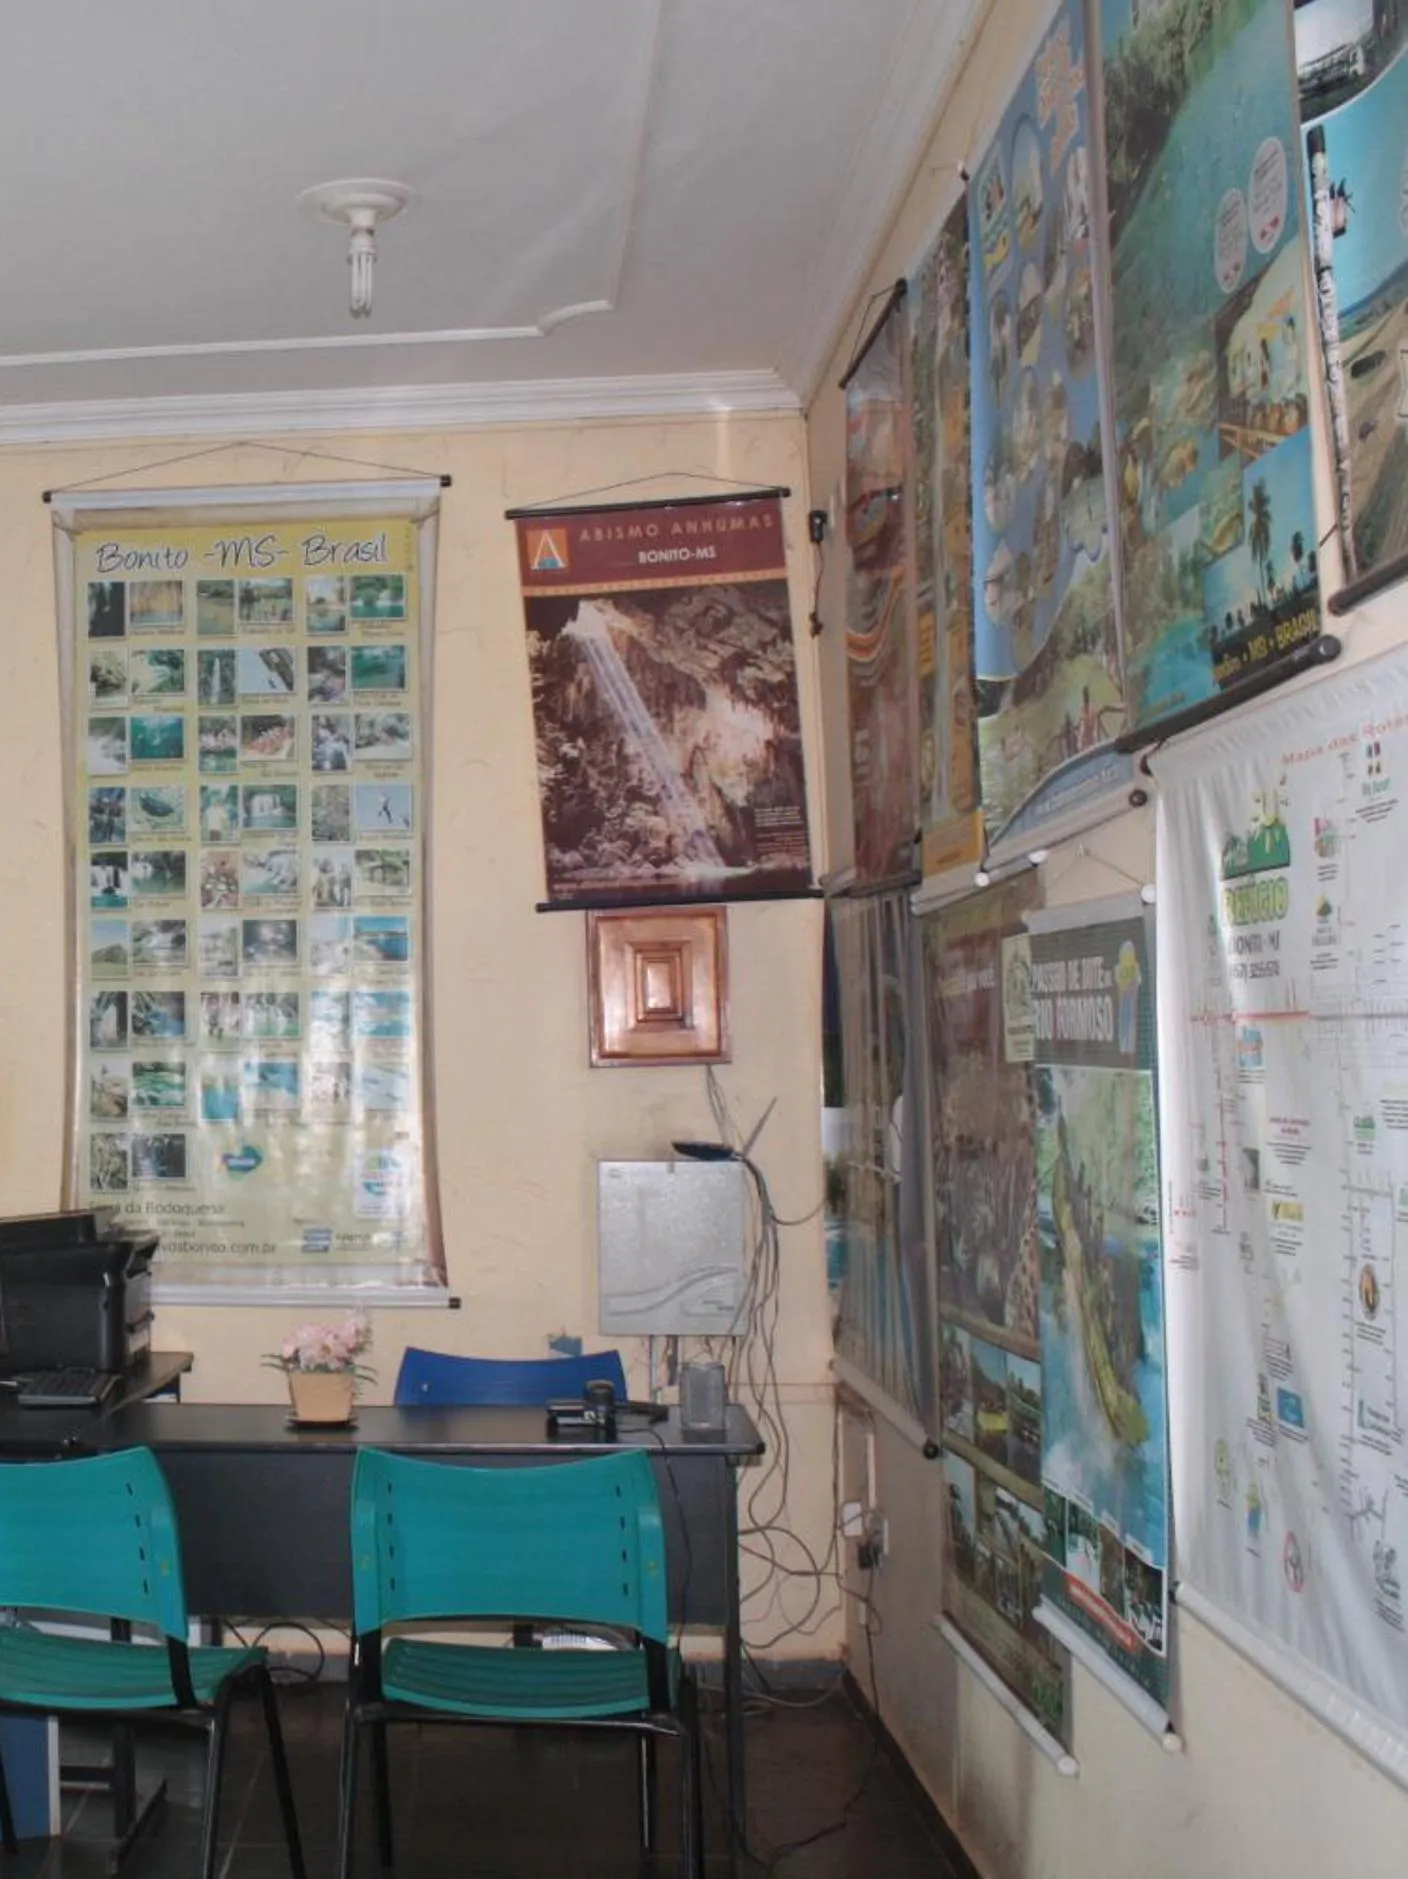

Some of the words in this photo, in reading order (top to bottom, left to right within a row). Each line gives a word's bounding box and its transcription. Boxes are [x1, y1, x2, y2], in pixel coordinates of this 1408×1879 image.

[578, 523, 659, 542] ABISMO
[670, 513, 774, 537] ANHUMAS
[95, 542, 189, 574] Bonito
[302, 532, 389, 566] Brasil
[637, 545, 717, 565] BONITO-MS
